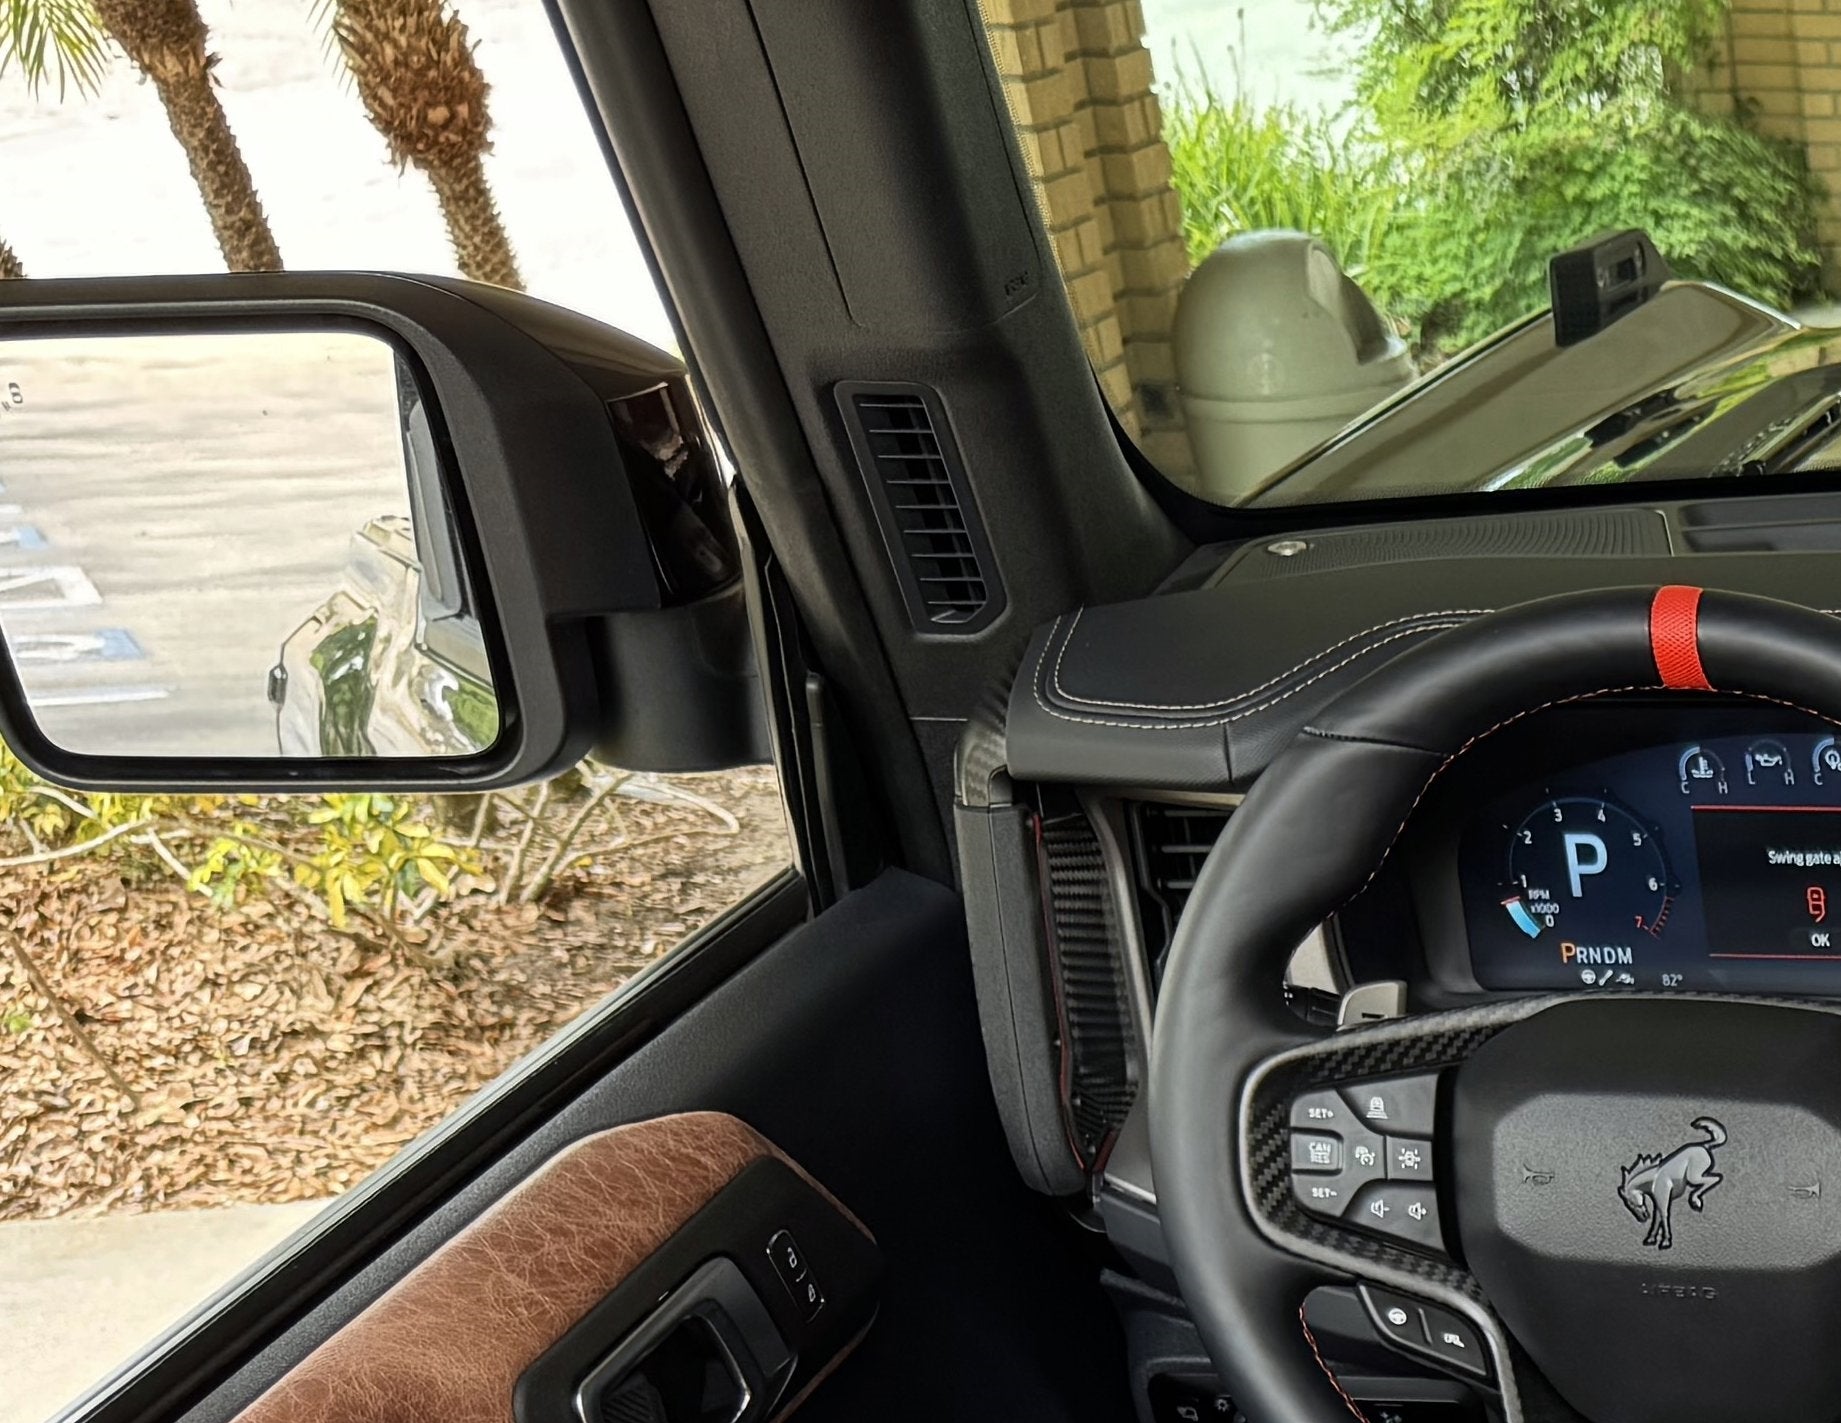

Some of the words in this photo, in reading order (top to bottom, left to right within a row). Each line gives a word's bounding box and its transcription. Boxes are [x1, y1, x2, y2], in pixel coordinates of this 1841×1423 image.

[1747, 773, 1755, 785] L
[1784, 773, 1795, 785] H
[1813, 774, 1823, 785] C
[1680, 782, 1690, 794] C
[1718, 783, 1728, 794] H
[1554, 808, 1563, 822] 3
[1597, 808, 1606, 822] 4
[1523, 830, 1532, 844] 2
[1632, 833, 1642, 847] 5
[1768, 850, 1804, 866] Swing
[1805, 852, 1832, 866] gate
[1564, 834, 1608, 897] P
[1520, 874, 1527, 888] 1
[1648, 877, 1658, 891] 6
[1545, 915, 1554, 927] 0
[1635, 915, 1642, 928] 7
[1811, 933, 1830, 948] OK
